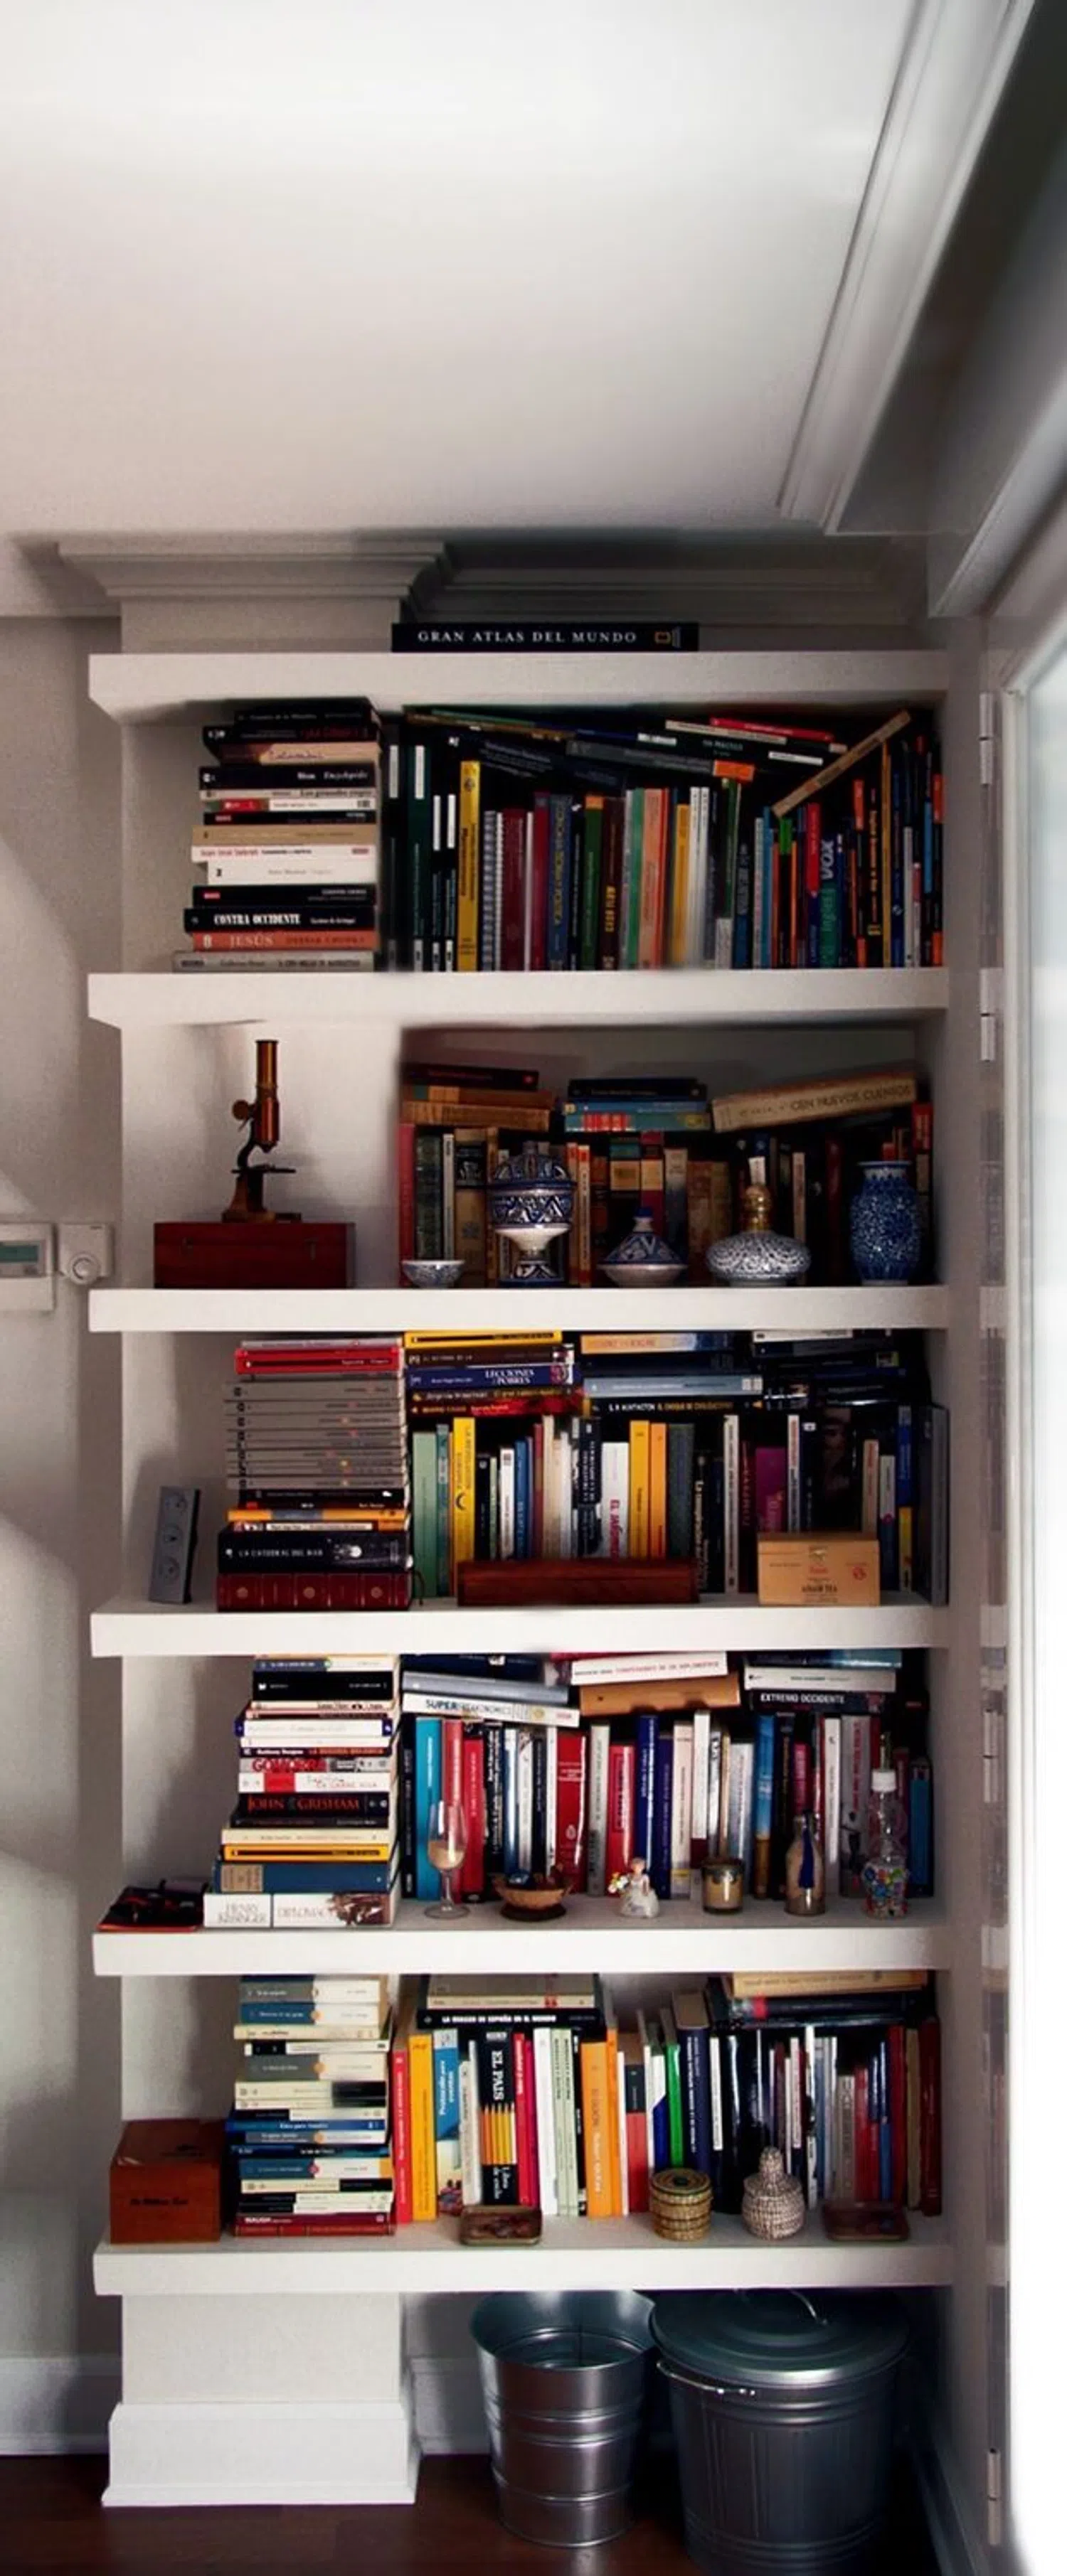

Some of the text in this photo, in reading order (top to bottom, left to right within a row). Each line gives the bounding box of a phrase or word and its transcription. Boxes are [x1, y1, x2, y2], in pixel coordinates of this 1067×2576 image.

[418, 631, 637, 643] GRAN ATLAS DEL MUNDO
[819, 839, 834, 880] VOX
[213, 914, 250, 926] CONTRA
[253, 913, 302, 926] OCCIDENTE
[230, 933, 274, 947] JESÚS
[610, 1500, 620, 1510] EL
[760, 1693, 845, 1704] EXTREMO OCCIDENTE
[248, 1795, 361, 1811] JOHN GRISHAM
[487, 2014, 512, 2023] ESPAÑA
[492, 2050, 503, 2068] EL
